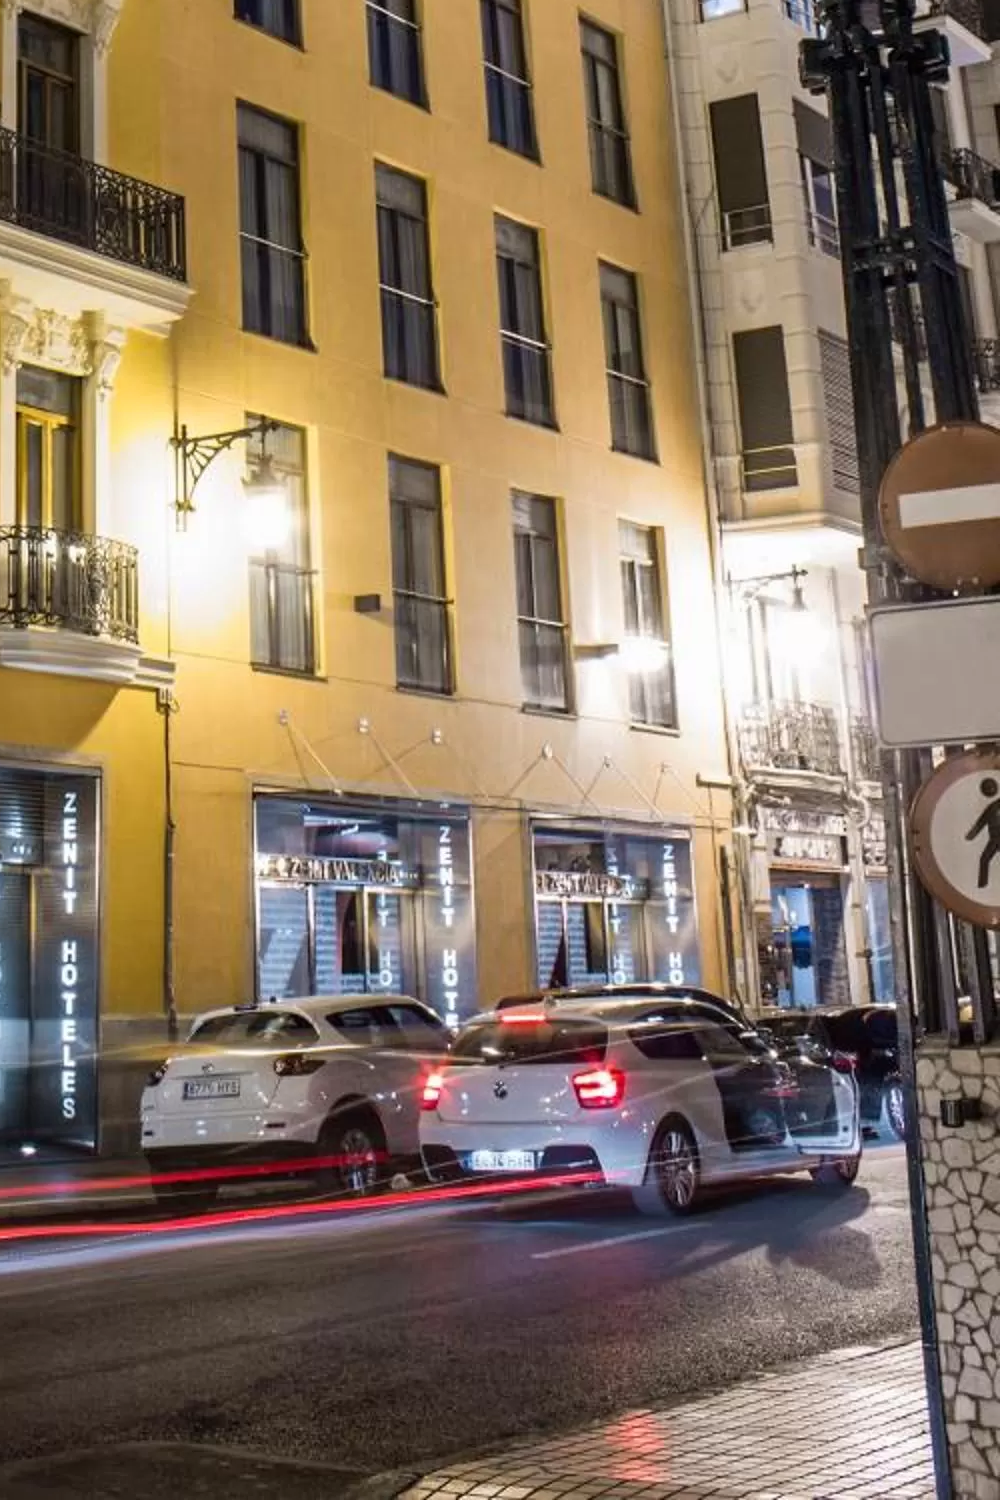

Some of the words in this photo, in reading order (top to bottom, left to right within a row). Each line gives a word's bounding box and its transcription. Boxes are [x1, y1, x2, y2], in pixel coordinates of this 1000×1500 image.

[63, 792, 78, 915] ZENIT
[438, 825, 456, 928] ZENIT
[663, 844, 680, 934] ZENIT
[60, 940, 78, 1120] HOTELES
